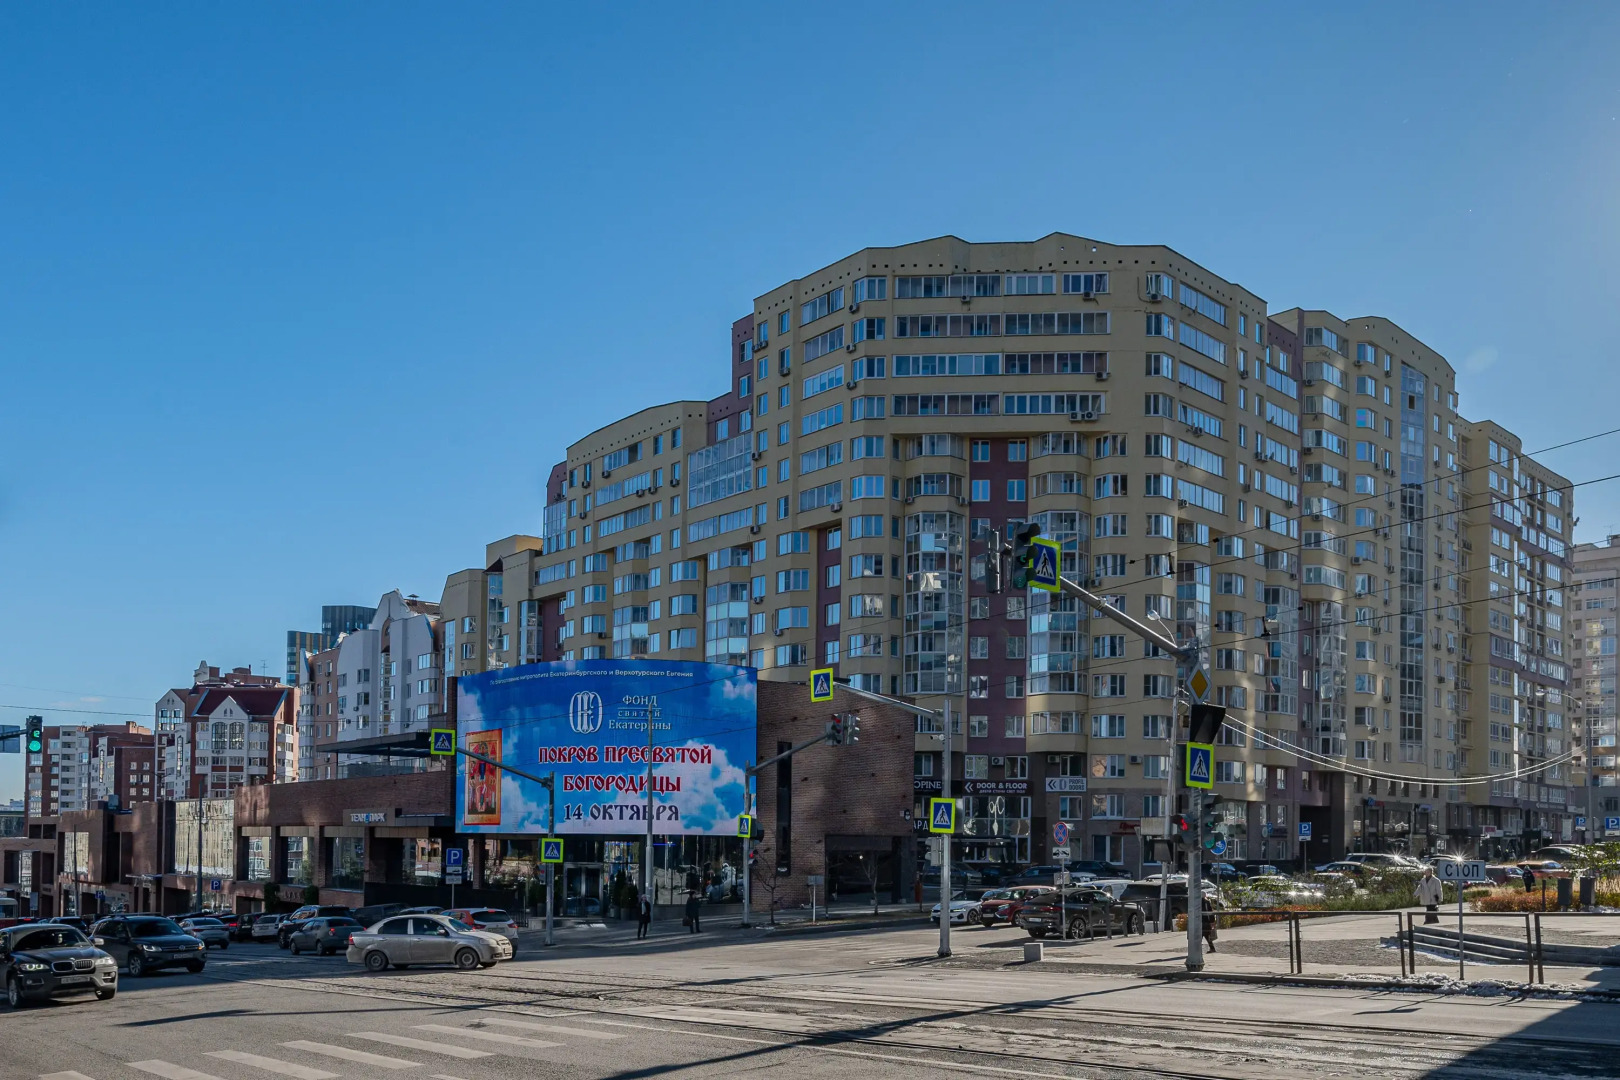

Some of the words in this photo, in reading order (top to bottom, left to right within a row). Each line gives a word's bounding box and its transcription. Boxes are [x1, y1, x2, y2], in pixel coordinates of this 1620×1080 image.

[550, 669, 607, 677] Екатеринбургского
[622, 694, 657, 706] ФОНД
[539, 746, 599, 763] ПОКРОВ
[604, 746, 712, 764] ПРЕСВЯТОЙ
[563, 775, 681, 796] БОГОРОДИЦЫ
[564, 803, 583, 821] 14
[1609, 818, 1617, 827] P
[451, 851, 460, 863] P
[1445, 864, 1479, 877] СТОП
